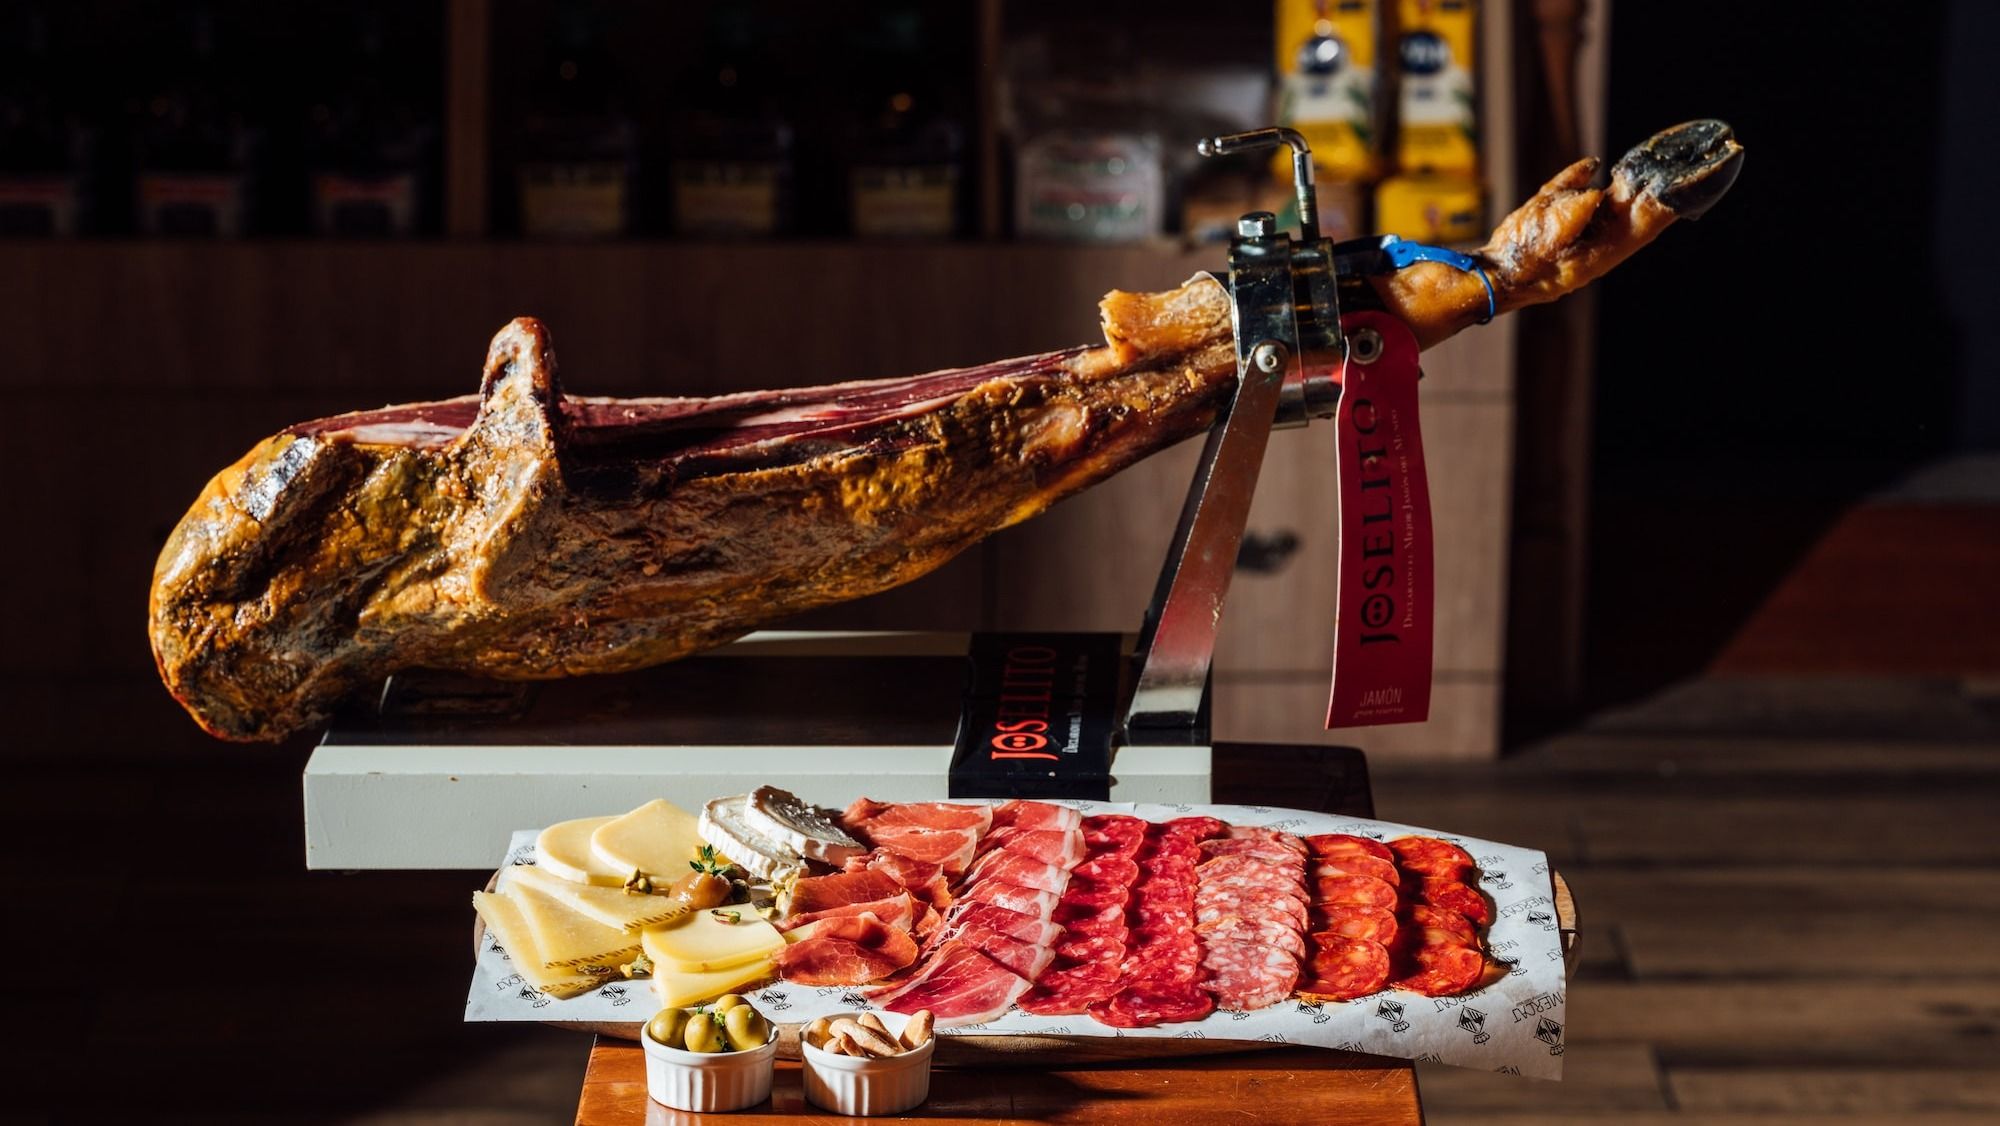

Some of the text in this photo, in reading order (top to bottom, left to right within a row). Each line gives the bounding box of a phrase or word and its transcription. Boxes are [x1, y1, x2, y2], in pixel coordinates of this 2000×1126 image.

[1351, 398, 1400, 647] JOSELITO
[991, 646, 1061, 760] JOSELITO
[1360, 685, 1402, 707] JAMÓN
[1511, 991, 1564, 1024] MERCAT
